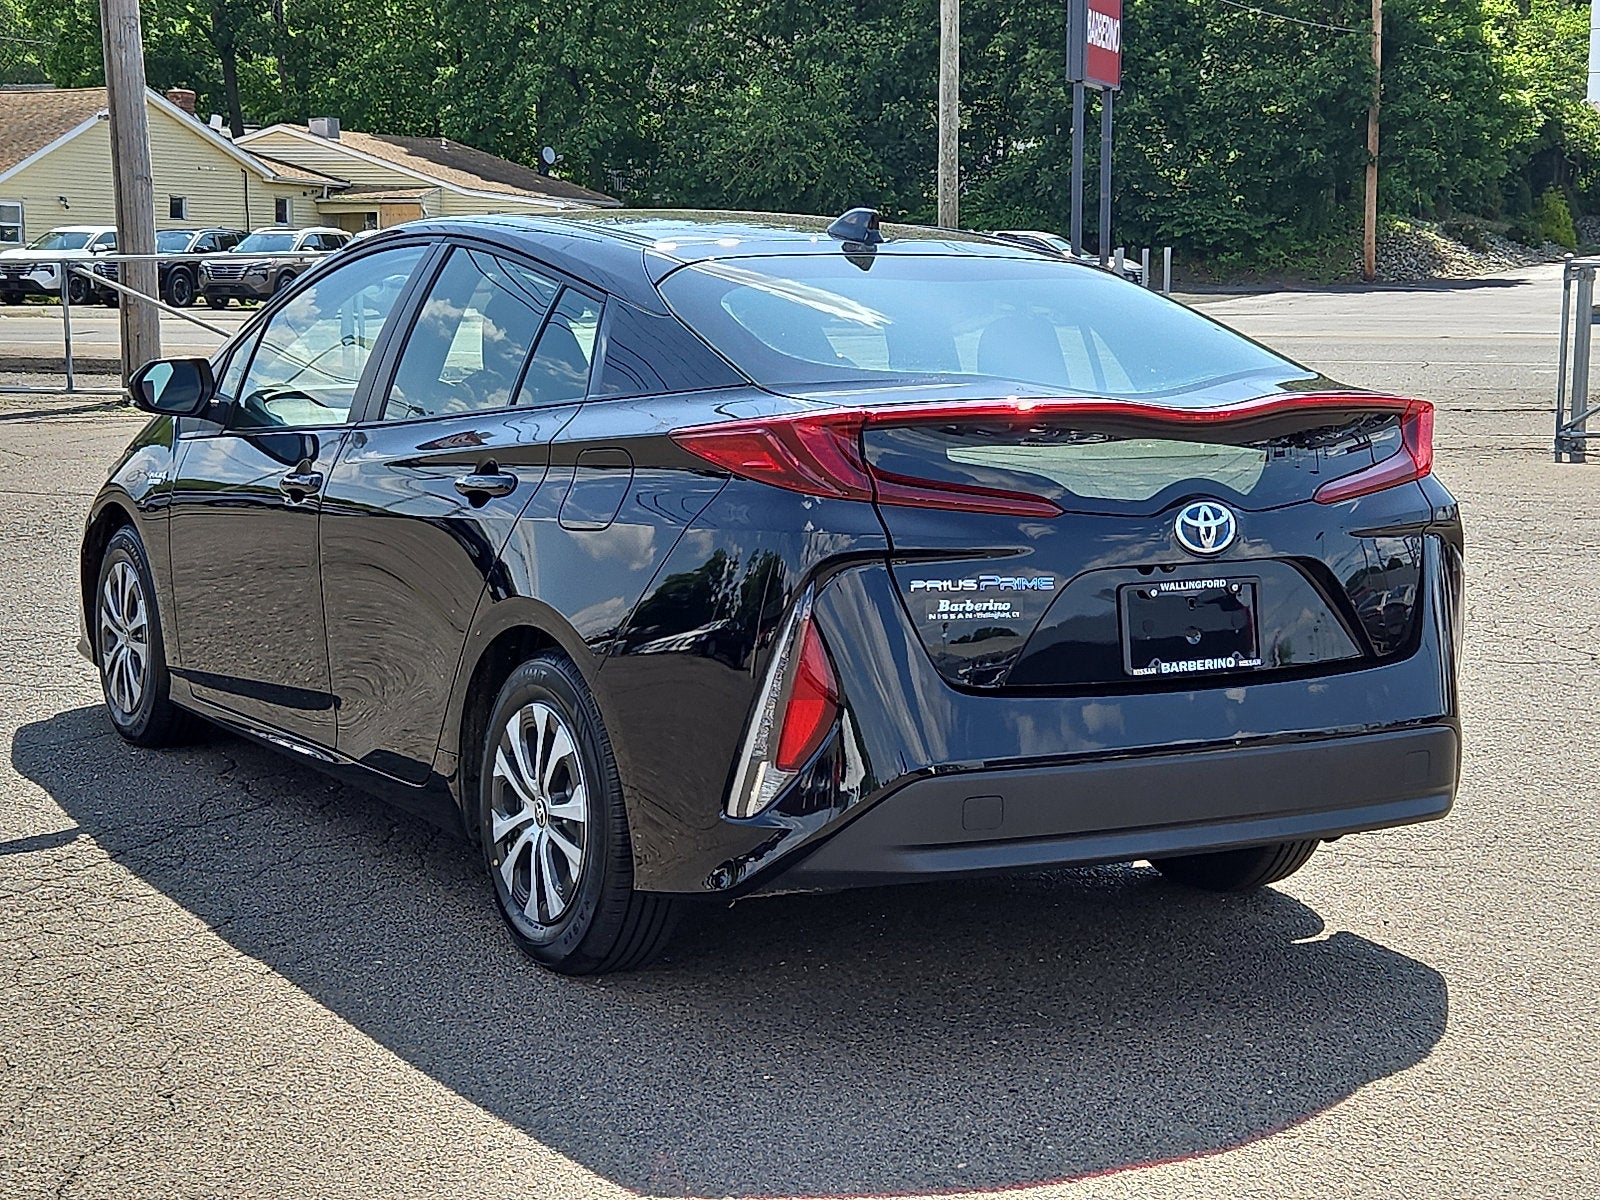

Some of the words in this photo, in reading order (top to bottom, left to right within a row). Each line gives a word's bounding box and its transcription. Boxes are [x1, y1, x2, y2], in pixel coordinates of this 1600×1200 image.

[1087, 8, 1120, 54] BARBERINO
[910, 579, 978, 592] PRIUS
[979, 575, 1055, 591] PRIME
[1159, 579, 1227, 592] WALLINGFORD
[937, 598, 1011, 612] Barberino
[928, 612, 973, 620] NISSAN
[1161, 657, 1235, 674] BARBERINO
